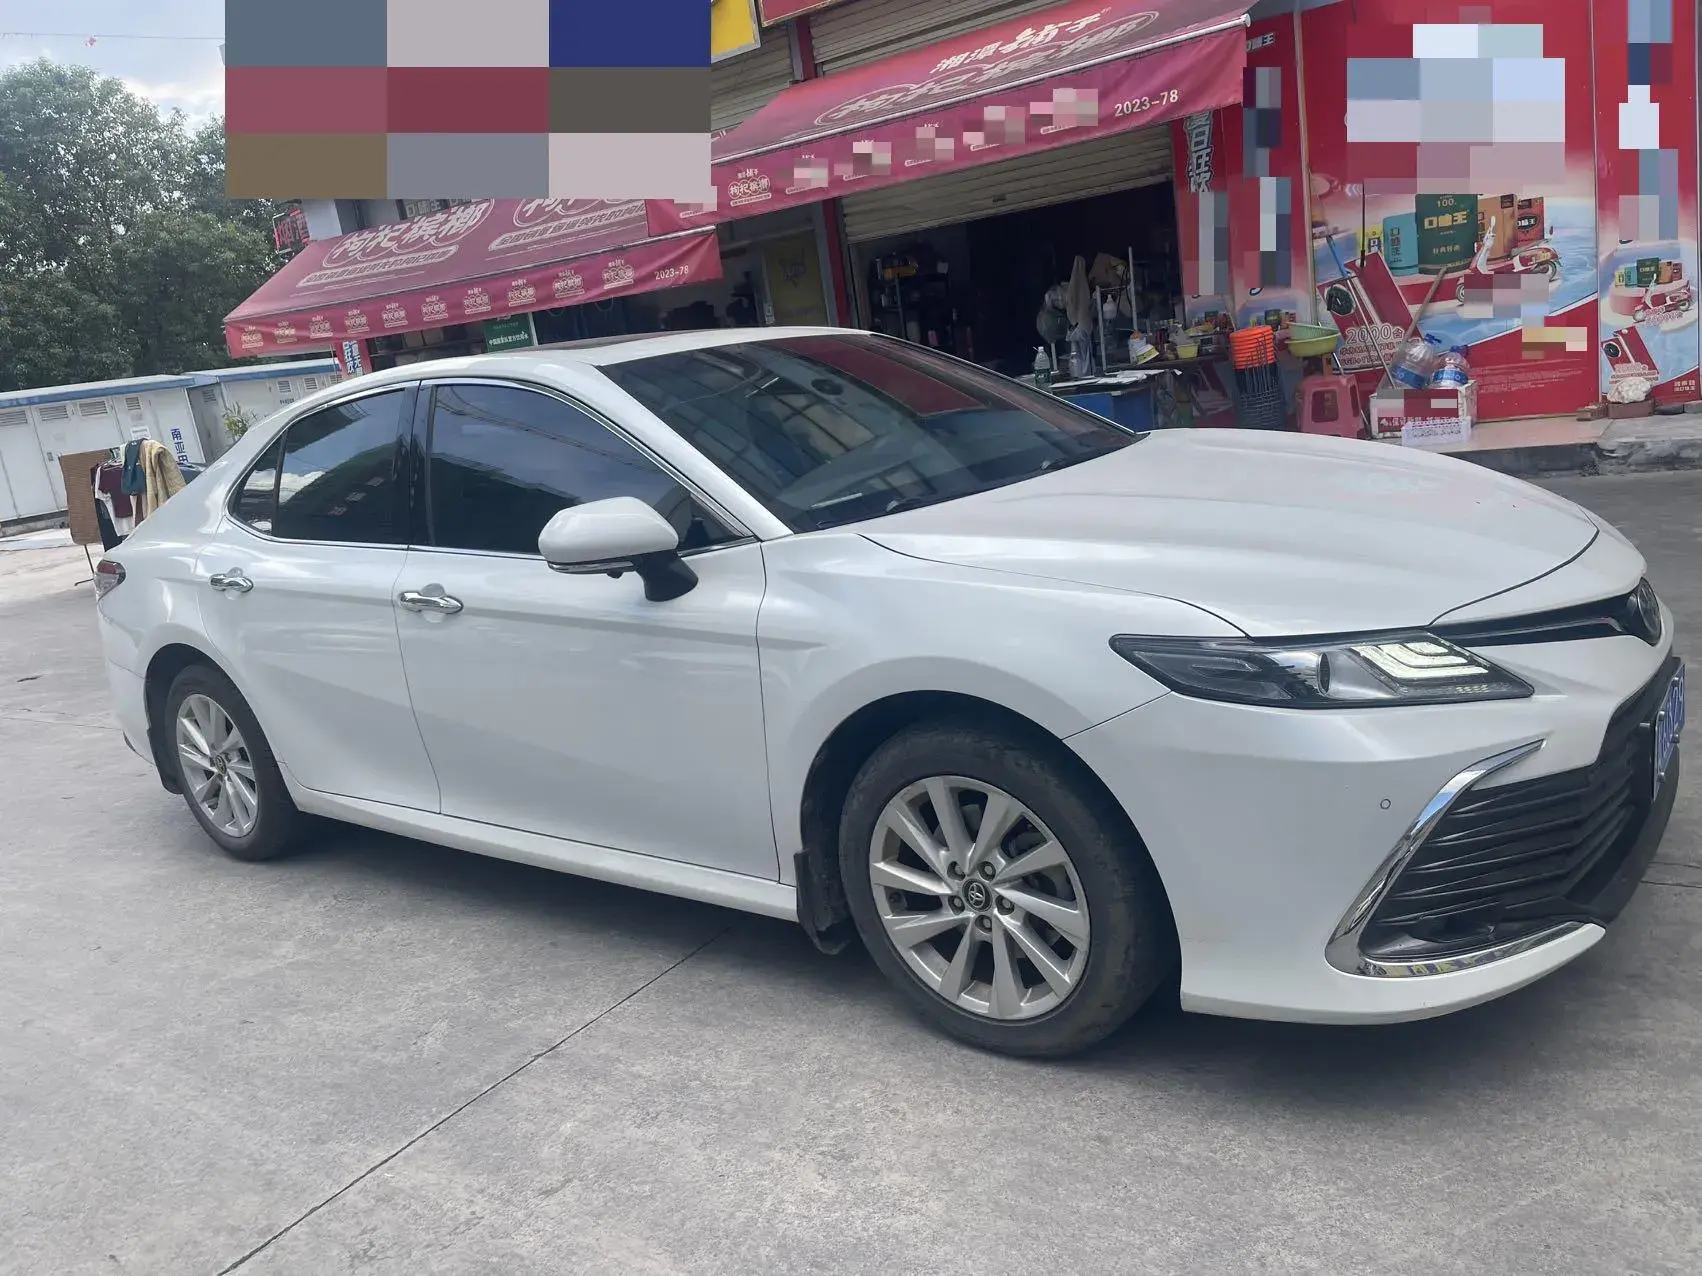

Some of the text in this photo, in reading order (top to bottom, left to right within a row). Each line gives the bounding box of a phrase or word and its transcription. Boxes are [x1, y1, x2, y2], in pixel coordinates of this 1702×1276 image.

[1114, 89, 1178, 117] 2023-78
[655, 265, 689, 281] 2023-78
[1346, 323, 1404, 345] 2000台
